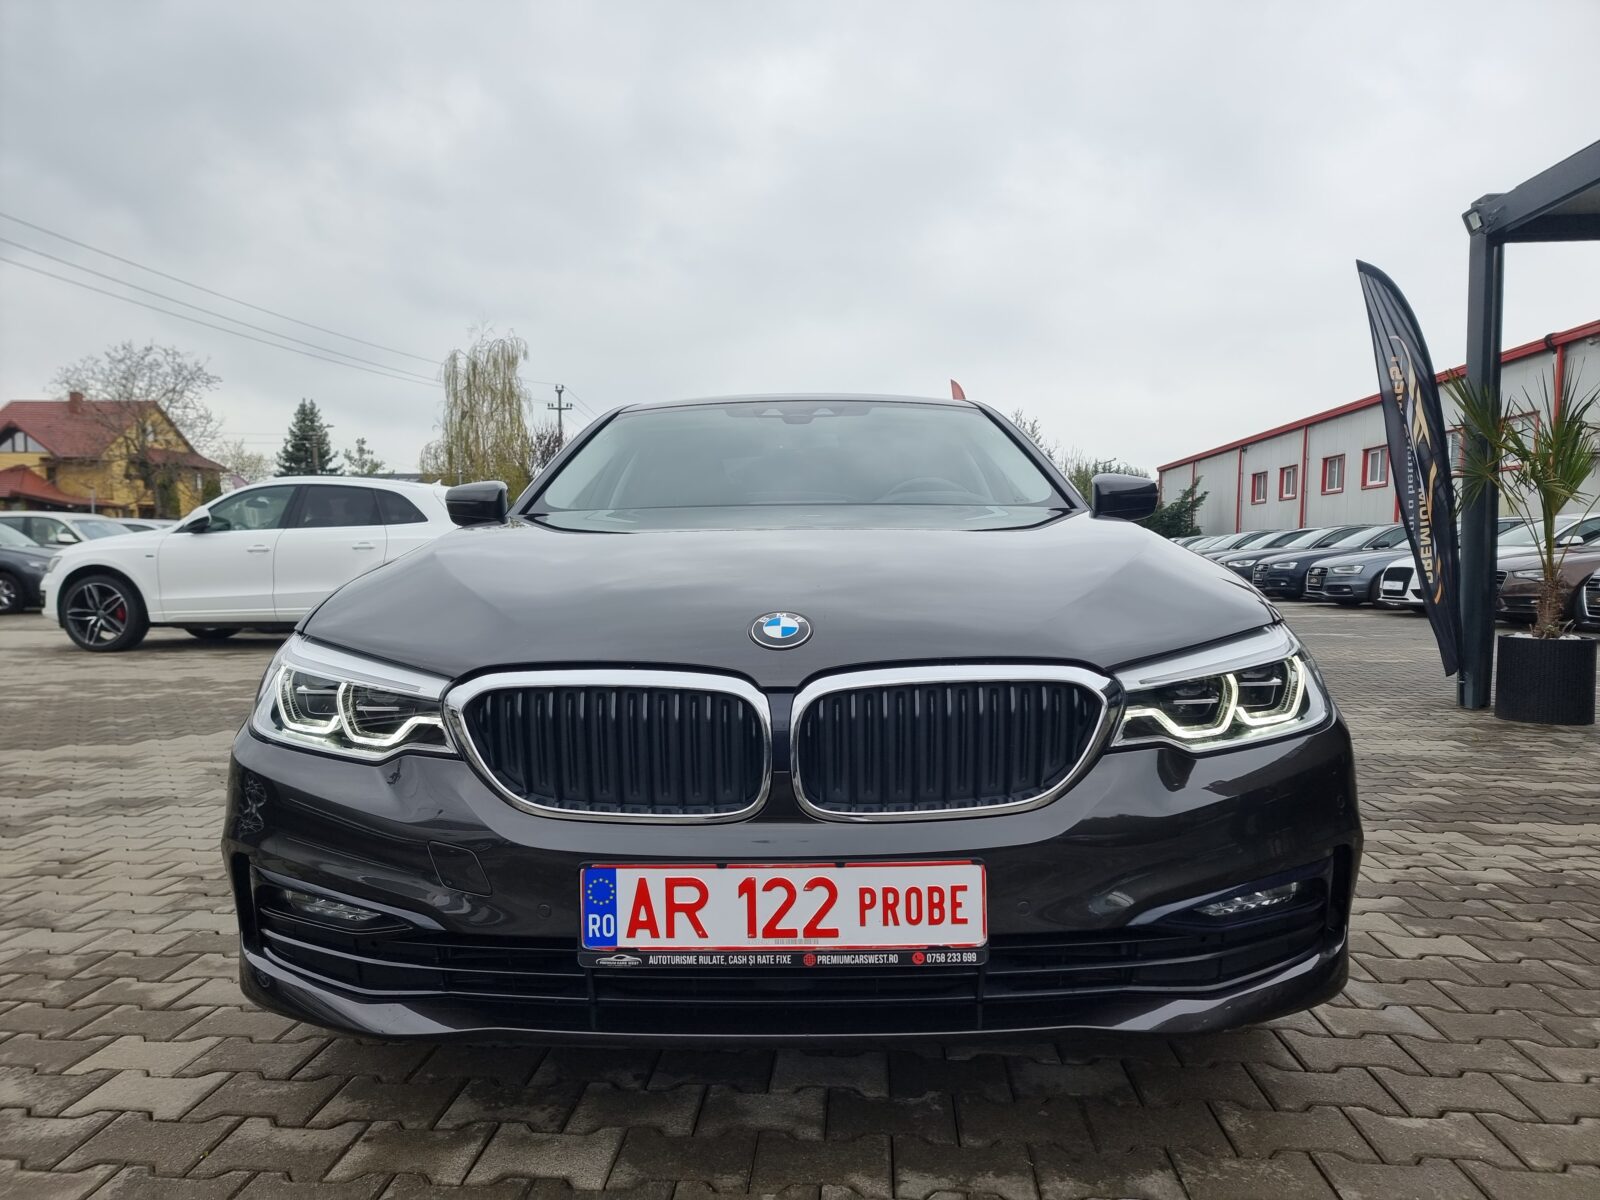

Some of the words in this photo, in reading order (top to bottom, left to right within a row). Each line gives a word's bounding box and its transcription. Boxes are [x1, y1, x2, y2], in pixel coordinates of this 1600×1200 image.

[626, 877, 709, 939] AR
[738, 876, 840, 939] 122
[858, 885, 968, 927] PROBE
[588, 913, 615, 938] RO
[648, 955, 697, 965] AUTOTURISME
[699, 955, 727, 966] RULATE,
[728, 955, 747, 965] CASH
[757, 955, 775, 964] RATE
[776, 954, 792, 964] FIXE
[817, 953, 899, 965] PREMIUMCARSWEST.RO
[947, 952, 961, 962] 233
[962, 952, 977, 962] 699
